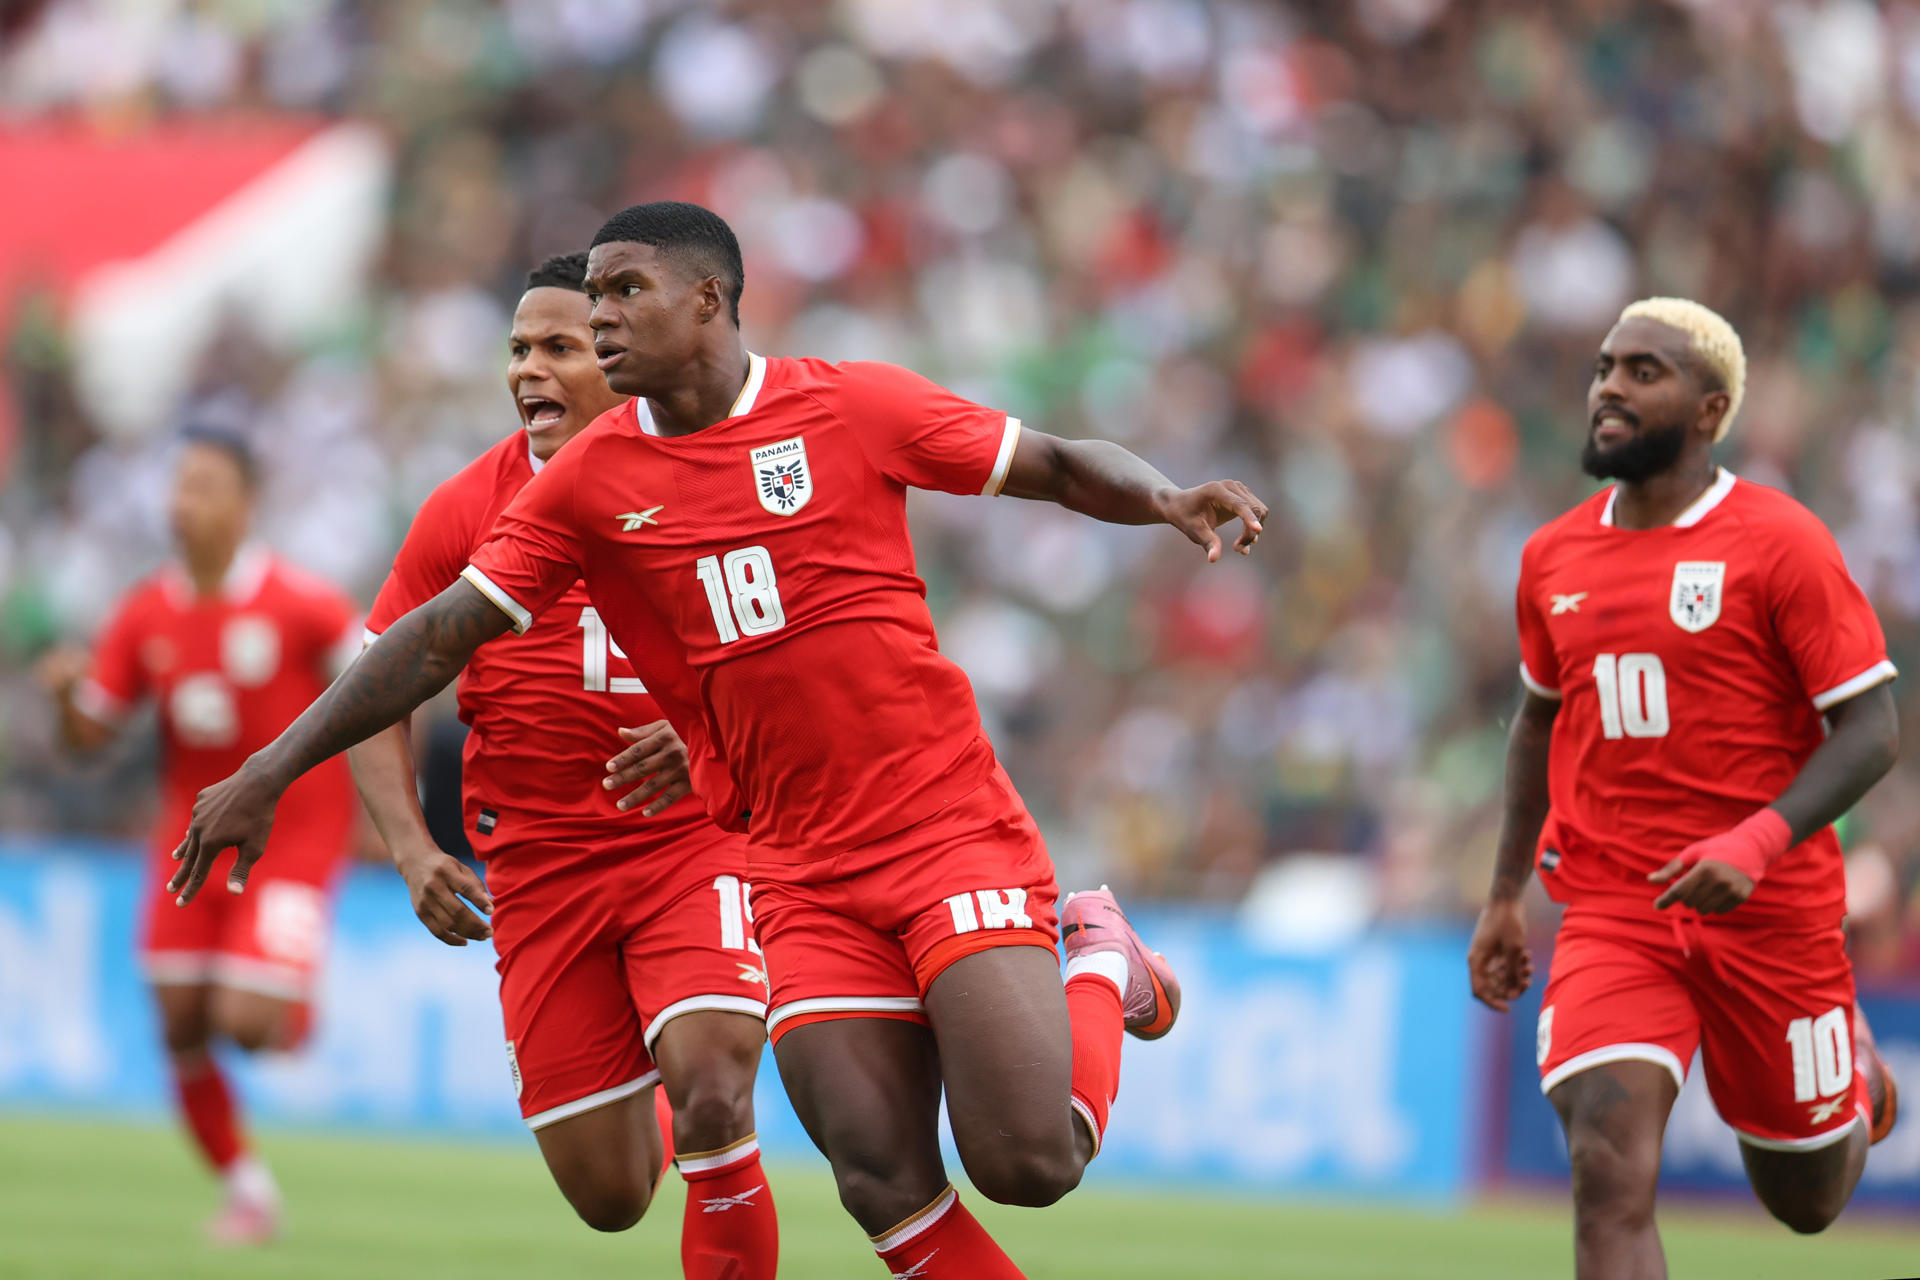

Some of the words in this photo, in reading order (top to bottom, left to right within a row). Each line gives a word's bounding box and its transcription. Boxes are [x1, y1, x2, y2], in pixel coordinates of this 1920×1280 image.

[696, 545, 786, 644] 18
[1592, 653, 1671, 740] 10
[712, 875, 762, 956] 1
[942, 888, 1032, 934] 18
[1786, 1006, 1853, 1103] 10
